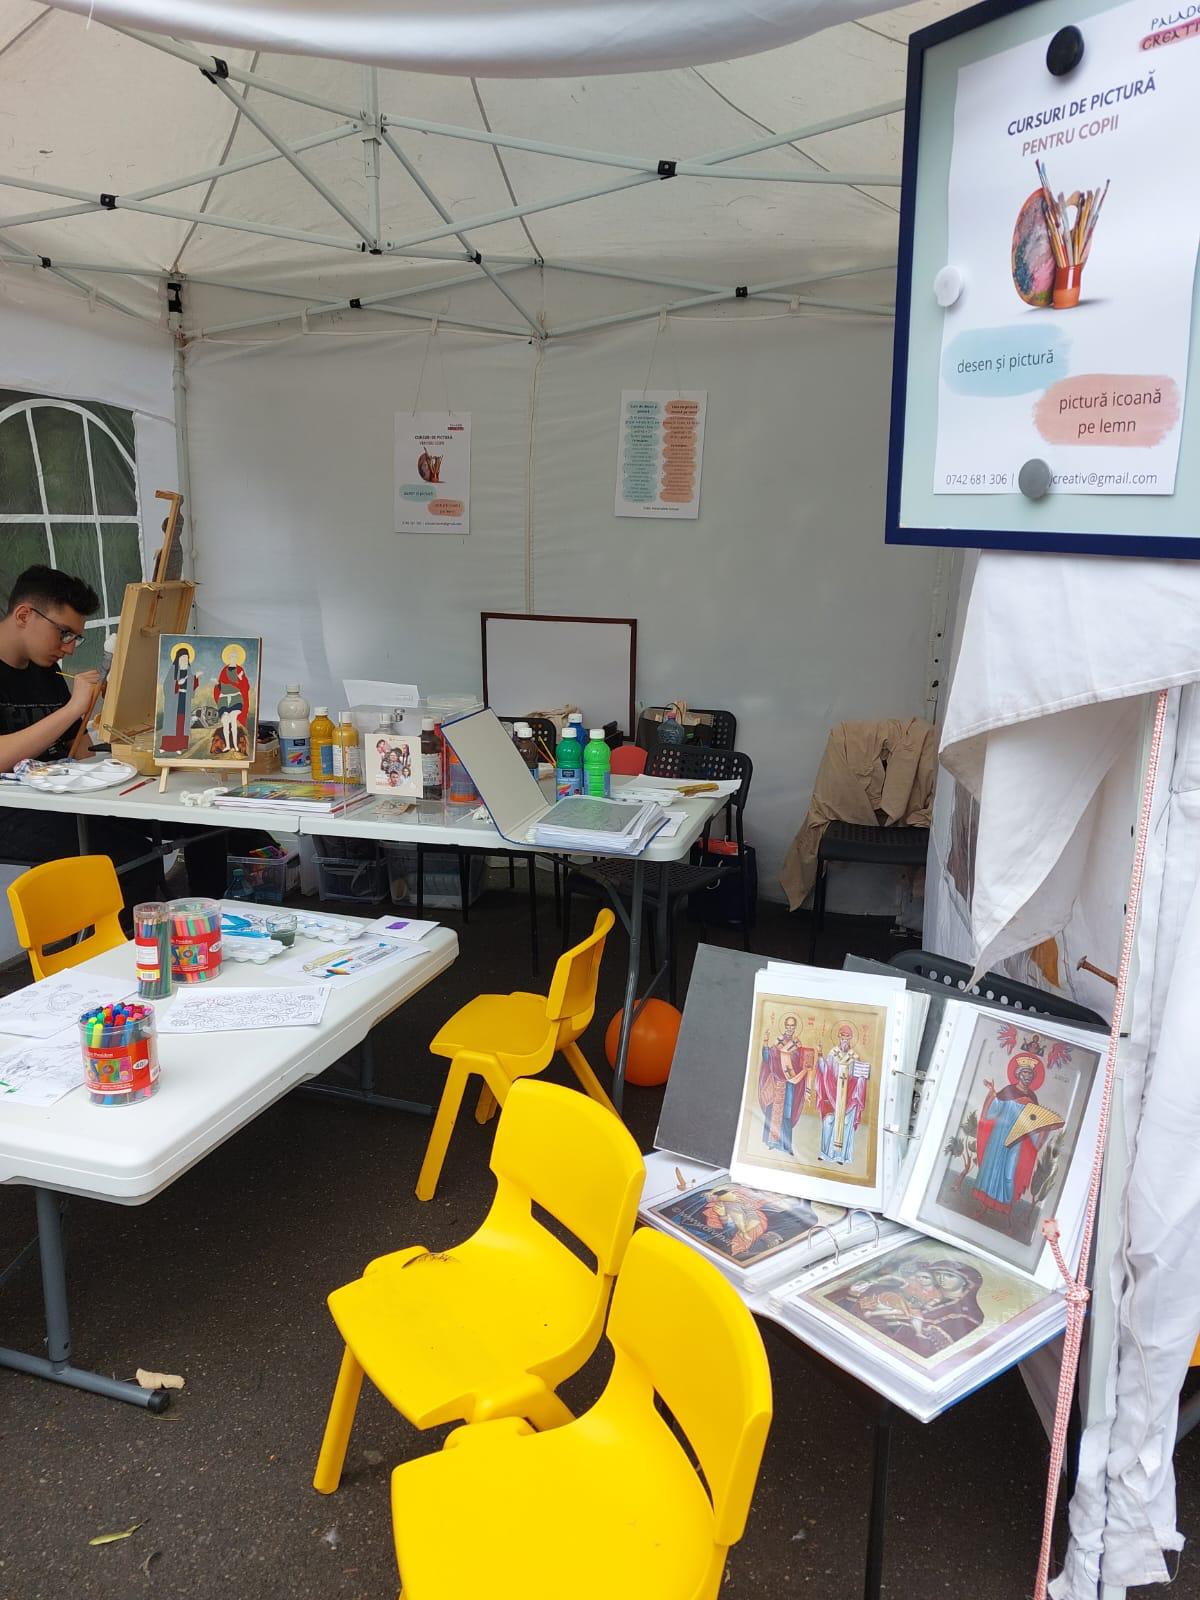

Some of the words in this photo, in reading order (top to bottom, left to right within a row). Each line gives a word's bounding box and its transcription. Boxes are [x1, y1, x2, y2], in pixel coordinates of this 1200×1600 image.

[1007, 105, 1066, 136] CURSURI
[1069, 98, 1087, 117] DE
[1090, 70, 1156, 111] PICTURĂ
[1022, 127, 1075, 156] PENTRU
[1078, 115, 1119, 140] COPII
[957, 359, 992, 373] desen
[996, 354, 1005, 372] și
[1009, 349, 1054, 371] pictură
[1059, 394, 1107, 414] pictură
[1112, 389, 1162, 407] icoană
[1077, 422, 1095, 439] pe
[1099, 418, 1136, 433] lemn
[946, 474, 969, 485] 0742
[970, 474, 986, 485] 681
[990, 474, 1007, 485] 306
